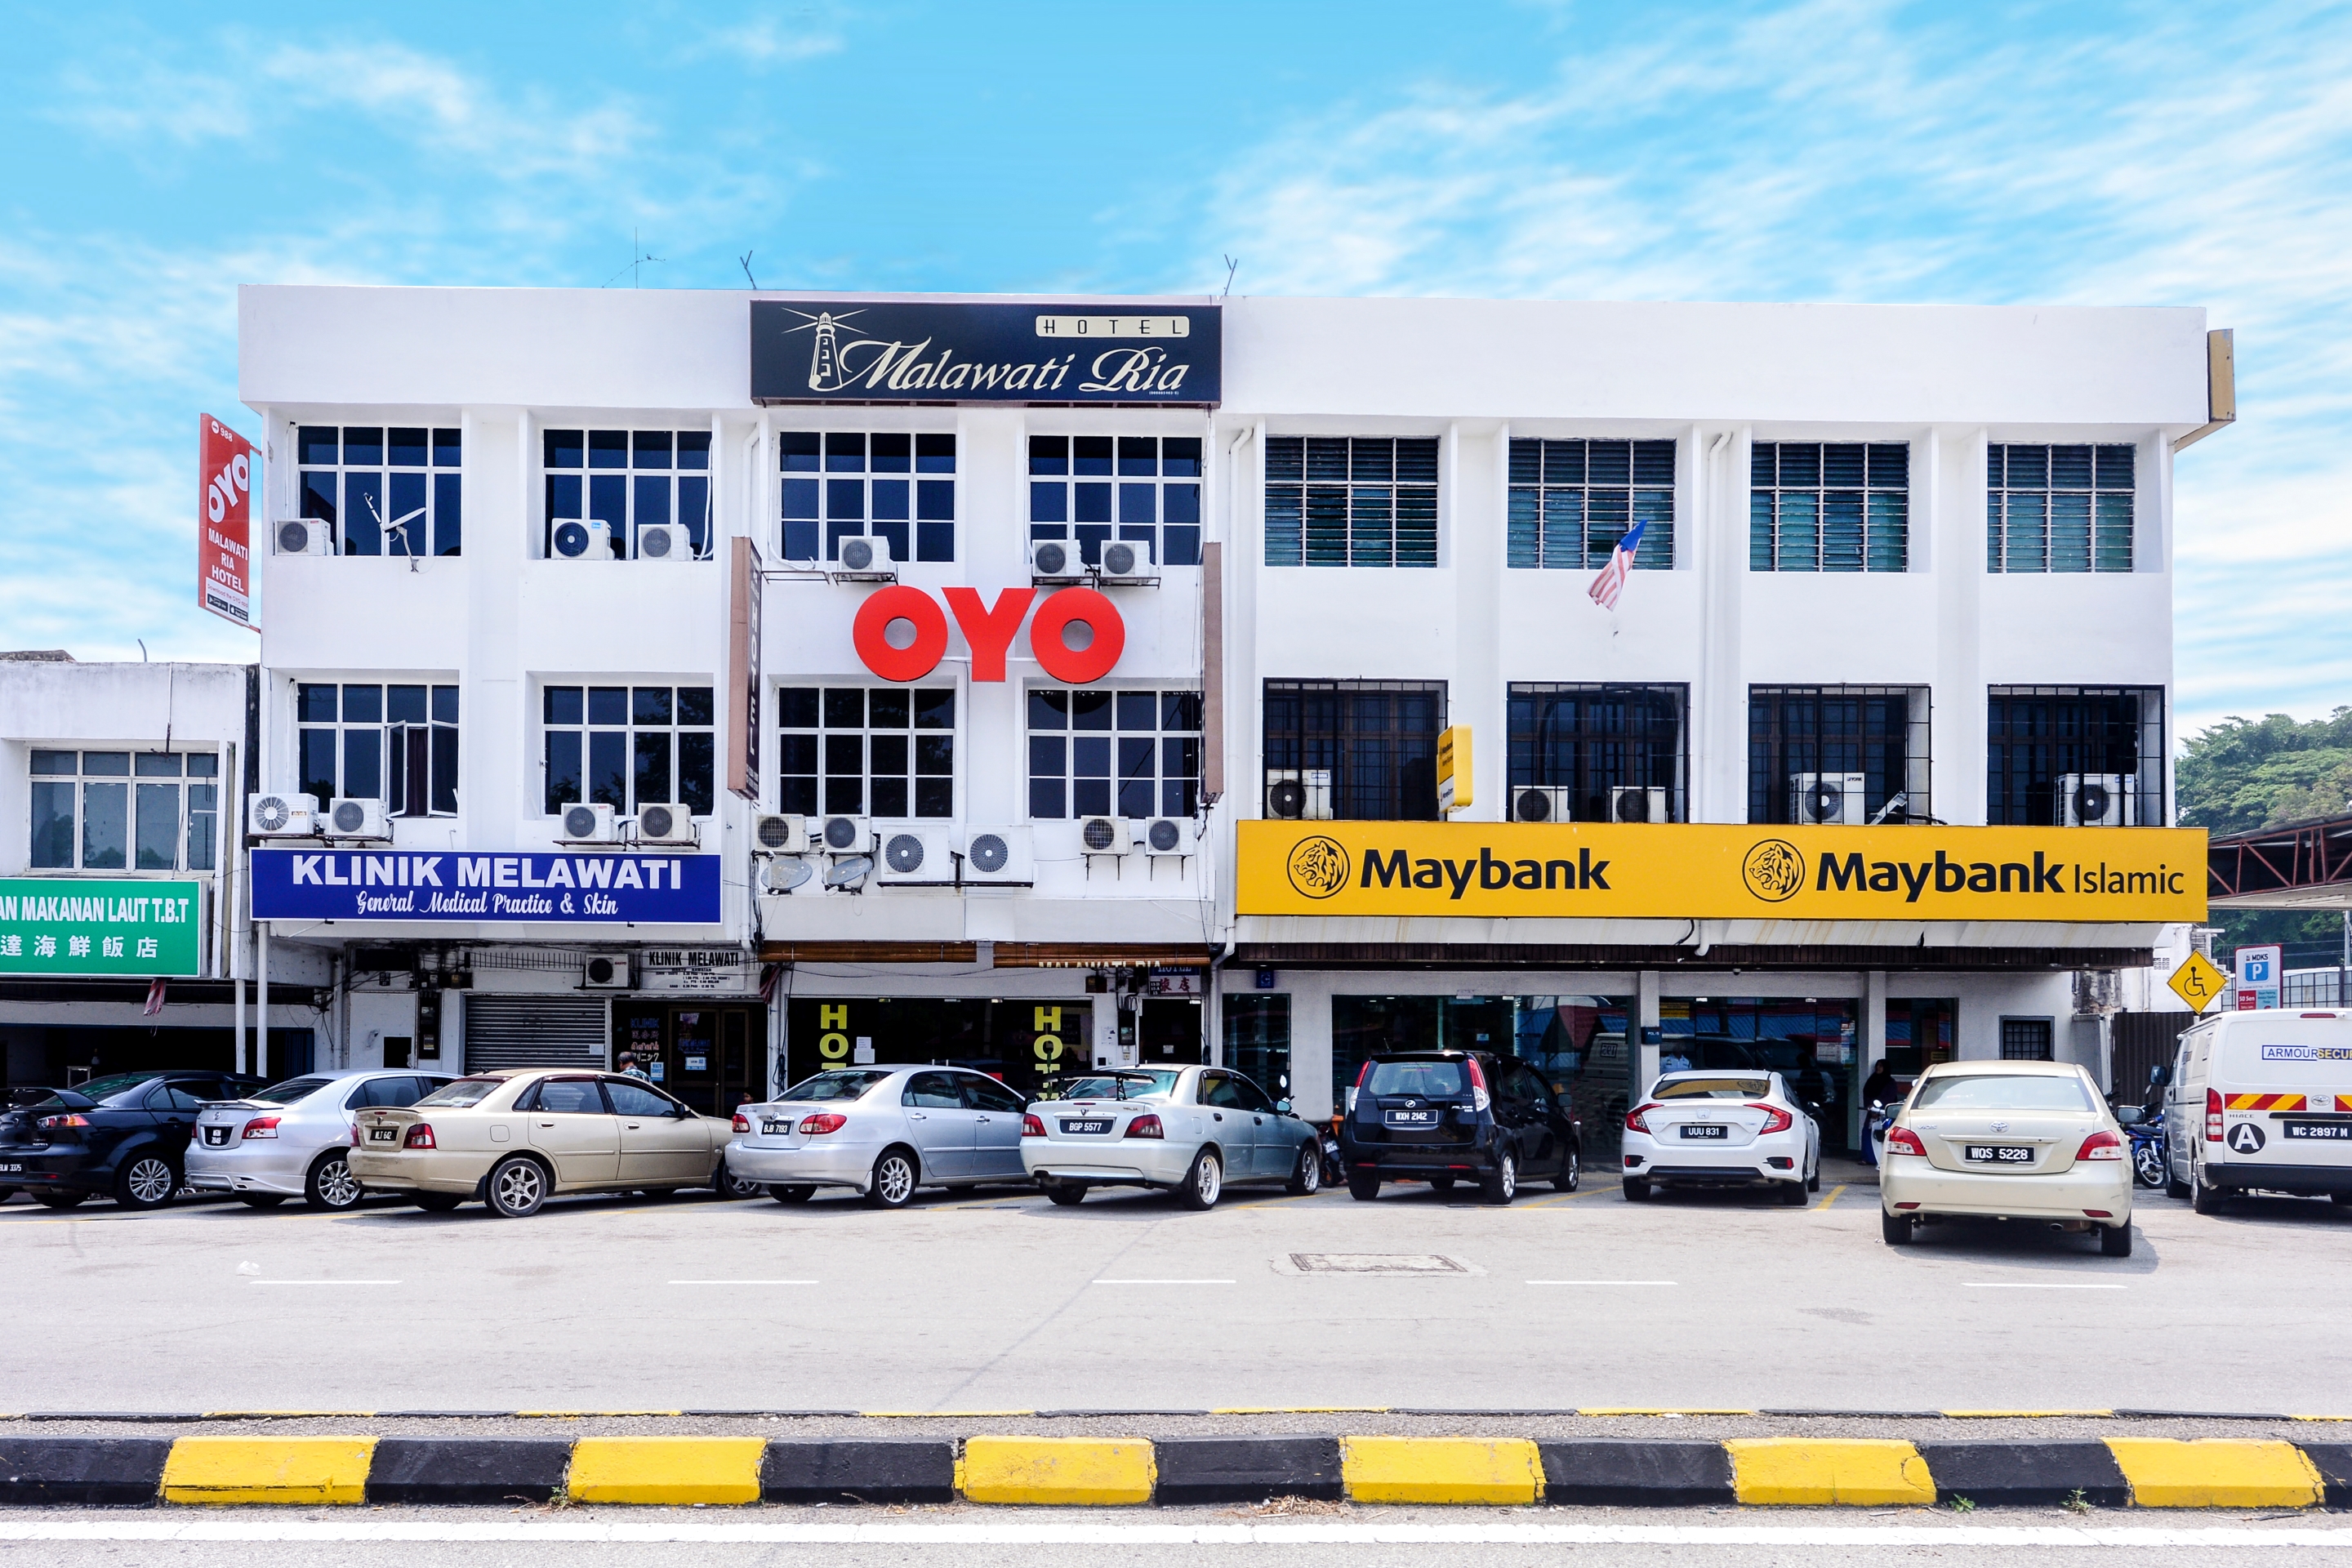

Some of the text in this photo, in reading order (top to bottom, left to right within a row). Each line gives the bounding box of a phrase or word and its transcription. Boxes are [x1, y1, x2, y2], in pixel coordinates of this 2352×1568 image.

[1043, 319, 1183, 335] HOTEL
[839, 336, 1190, 392] Malawati Ria
[220, 427, 233, 442] 988
[208, 453, 248, 523] OYO
[208, 528, 248, 561] MALAWATI
[221, 552, 234, 571] RIA
[212, 564, 244, 592] HOTEL
[853, 585, 1125, 684] OYO
[750, 601, 759, 756] HOTEL
[292, 855, 681, 889] KLINIK MELAWATI
[1361, 847, 1611, 899] Maybank
[1816, 850, 2185, 902] Maybank Islamic
[21, 897, 104, 921] MAKANAN
[108, 898, 149, 922] LAUT
[152, 898, 189, 923] T.B.T
[356, 890, 618, 915] General Medical Practice & Skin
[649, 951, 739, 966] KLINIK MELAWATI
[2252, 964, 2262, 980] P
[1069, 1122, 1102, 1132] BGP 5577
[1410, 1112, 1428, 1120] 2142
[775, 1125, 788, 1134] 7193
[1688, 1128, 1719, 1136] UUU 831
[2234, 1125, 2261, 1150] A
[2292, 1127, 2348, 1137] WC 2897 M
[1998, 1148, 2028, 1160] 5228
